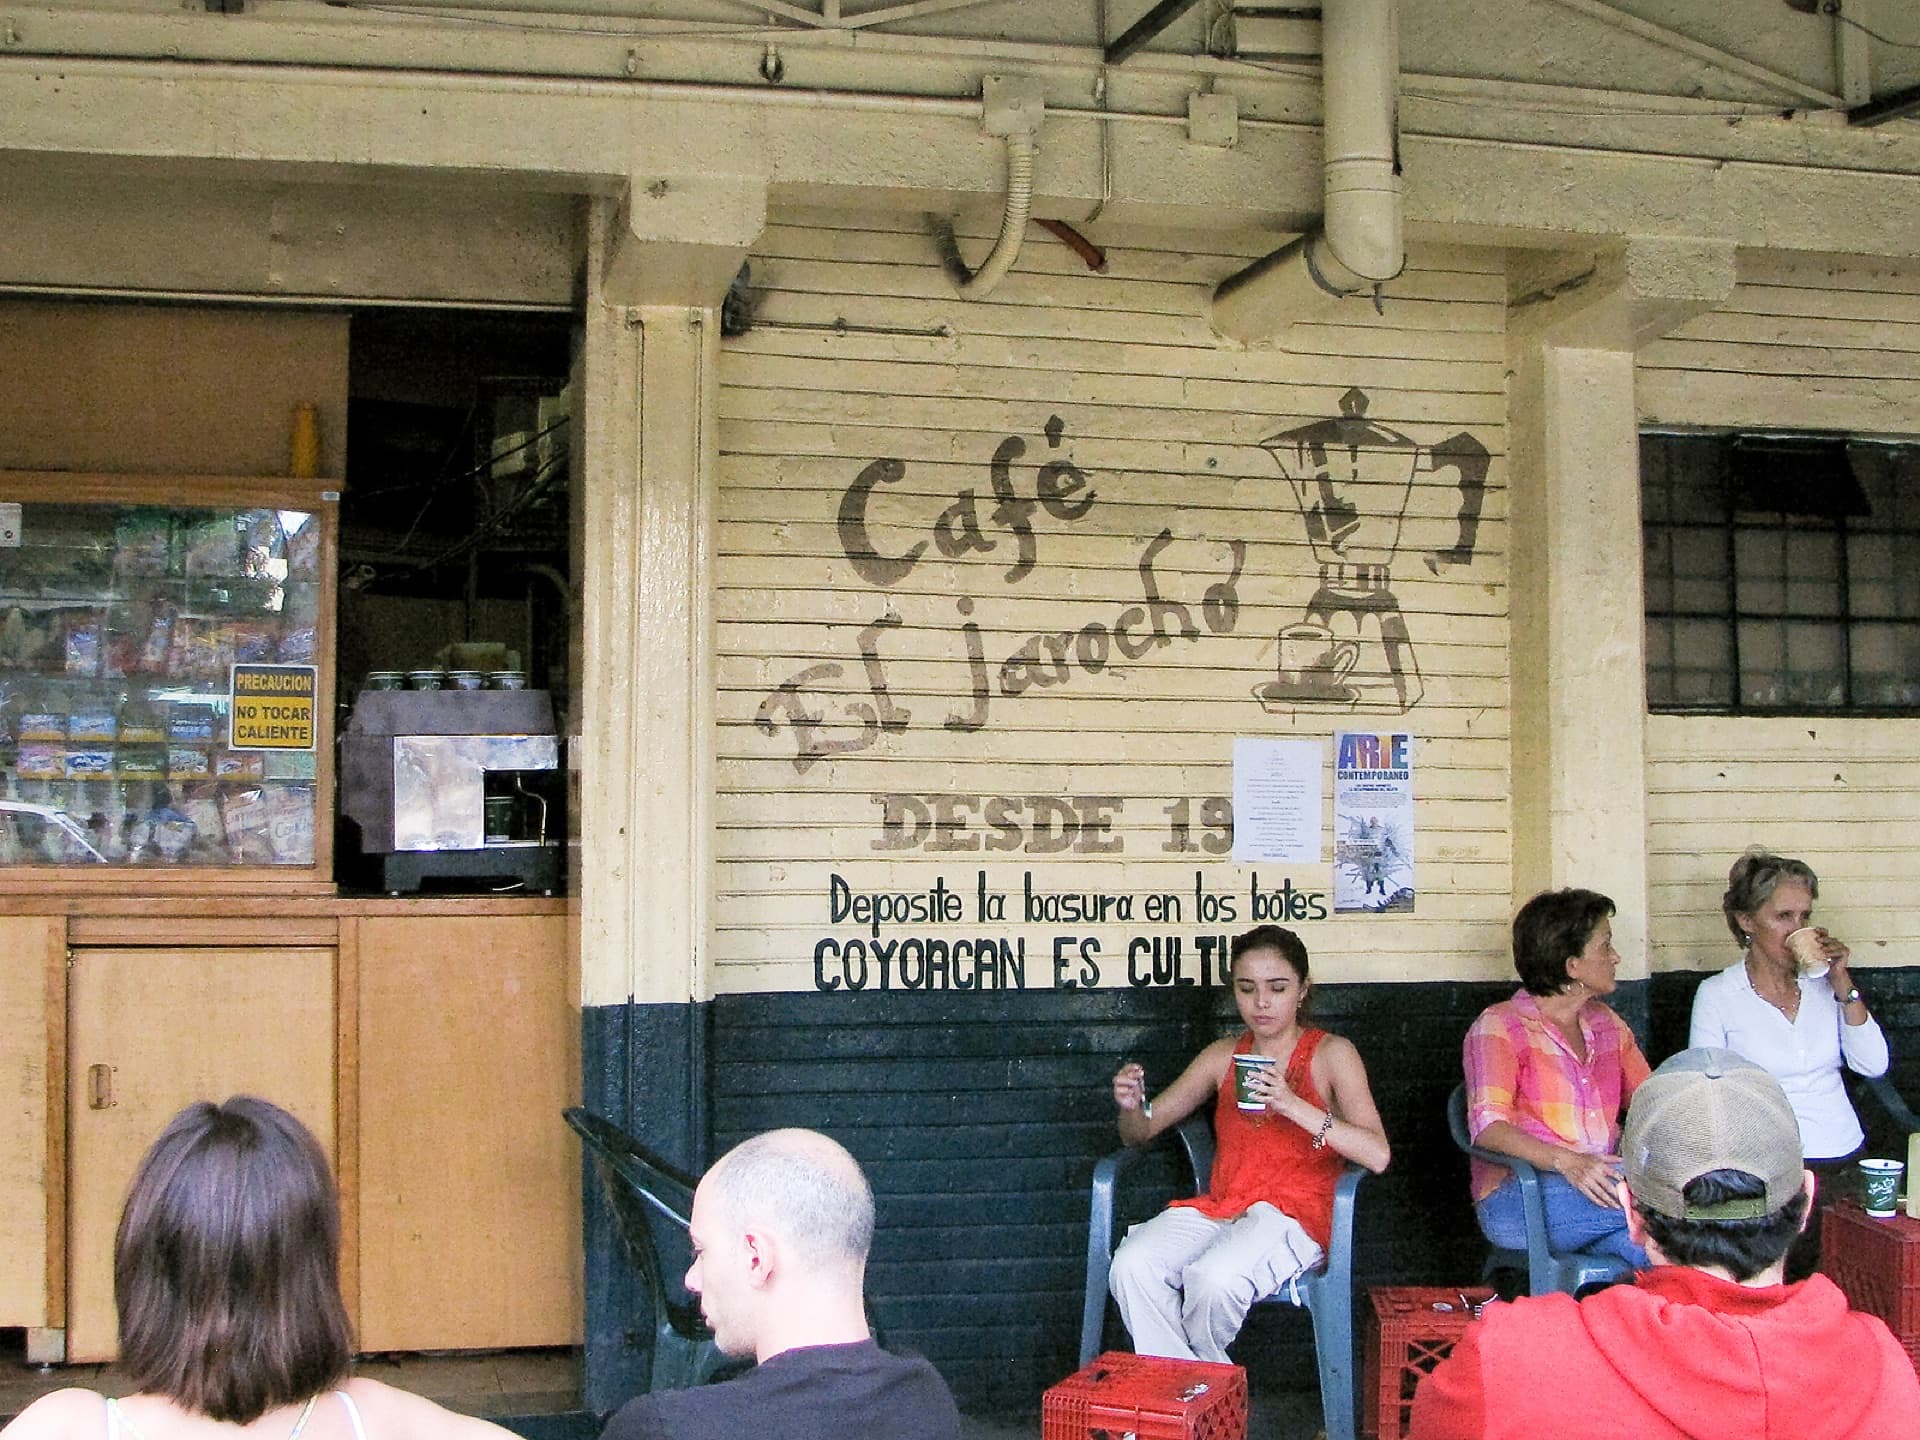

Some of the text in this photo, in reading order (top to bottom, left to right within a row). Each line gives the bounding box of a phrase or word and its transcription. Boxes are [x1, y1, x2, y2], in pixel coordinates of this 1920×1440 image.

[838, 414, 1097, 584] Café
[237, 673, 312, 691] PRECAUCION
[755, 614, 911, 775] El
[237, 706, 311, 721] NO TOCAR
[237, 725, 309, 740] CALIENTE
[1339, 734, 1409, 769] ARTE
[1337, 770, 1409, 781] CONTEMPORANEO
[870, 793, 1124, 853] DESDE
[831, 870, 1328, 938] Deposite la basura en los botes
[814, 937, 1025, 991] COYOACAN
[1053, 936, 1101, 989] ES
